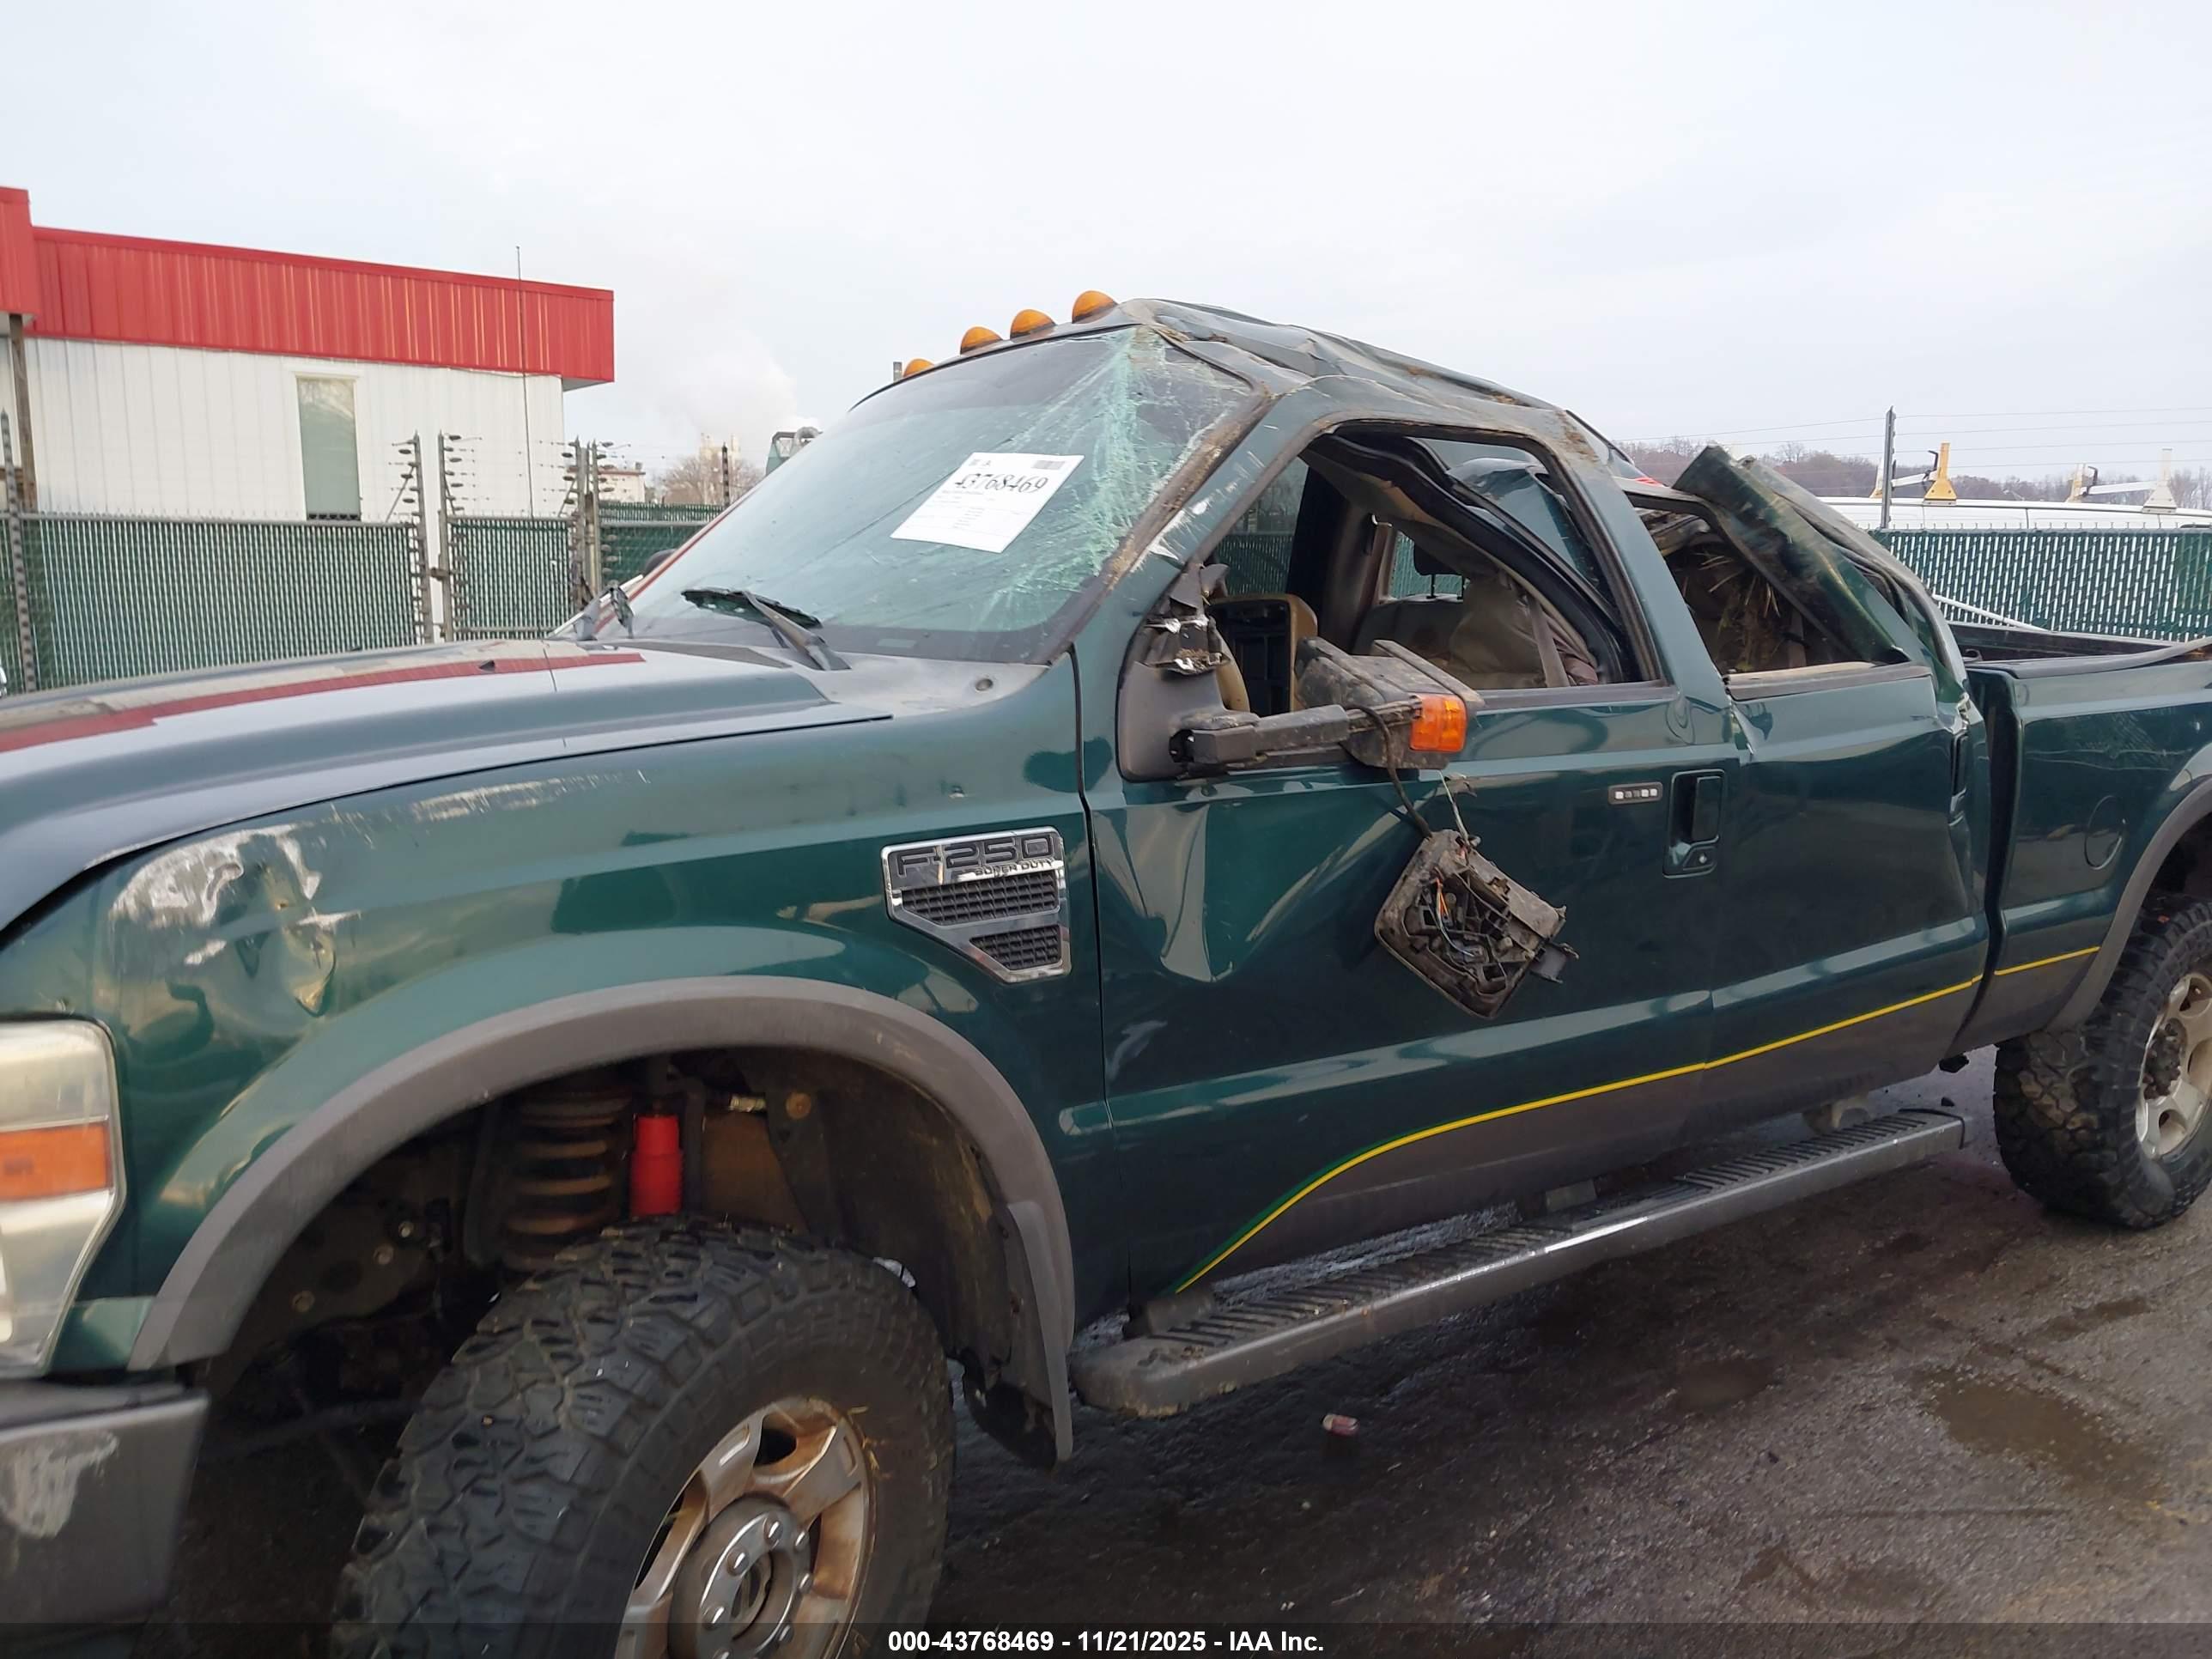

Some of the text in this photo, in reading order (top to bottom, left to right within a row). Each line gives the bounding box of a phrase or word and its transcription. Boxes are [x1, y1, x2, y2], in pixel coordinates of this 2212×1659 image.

[954, 472, 1049, 494] 43768469
[897, 835, 1054, 877] F-250
[974, 857, 1055, 877] SUPER DUTY
